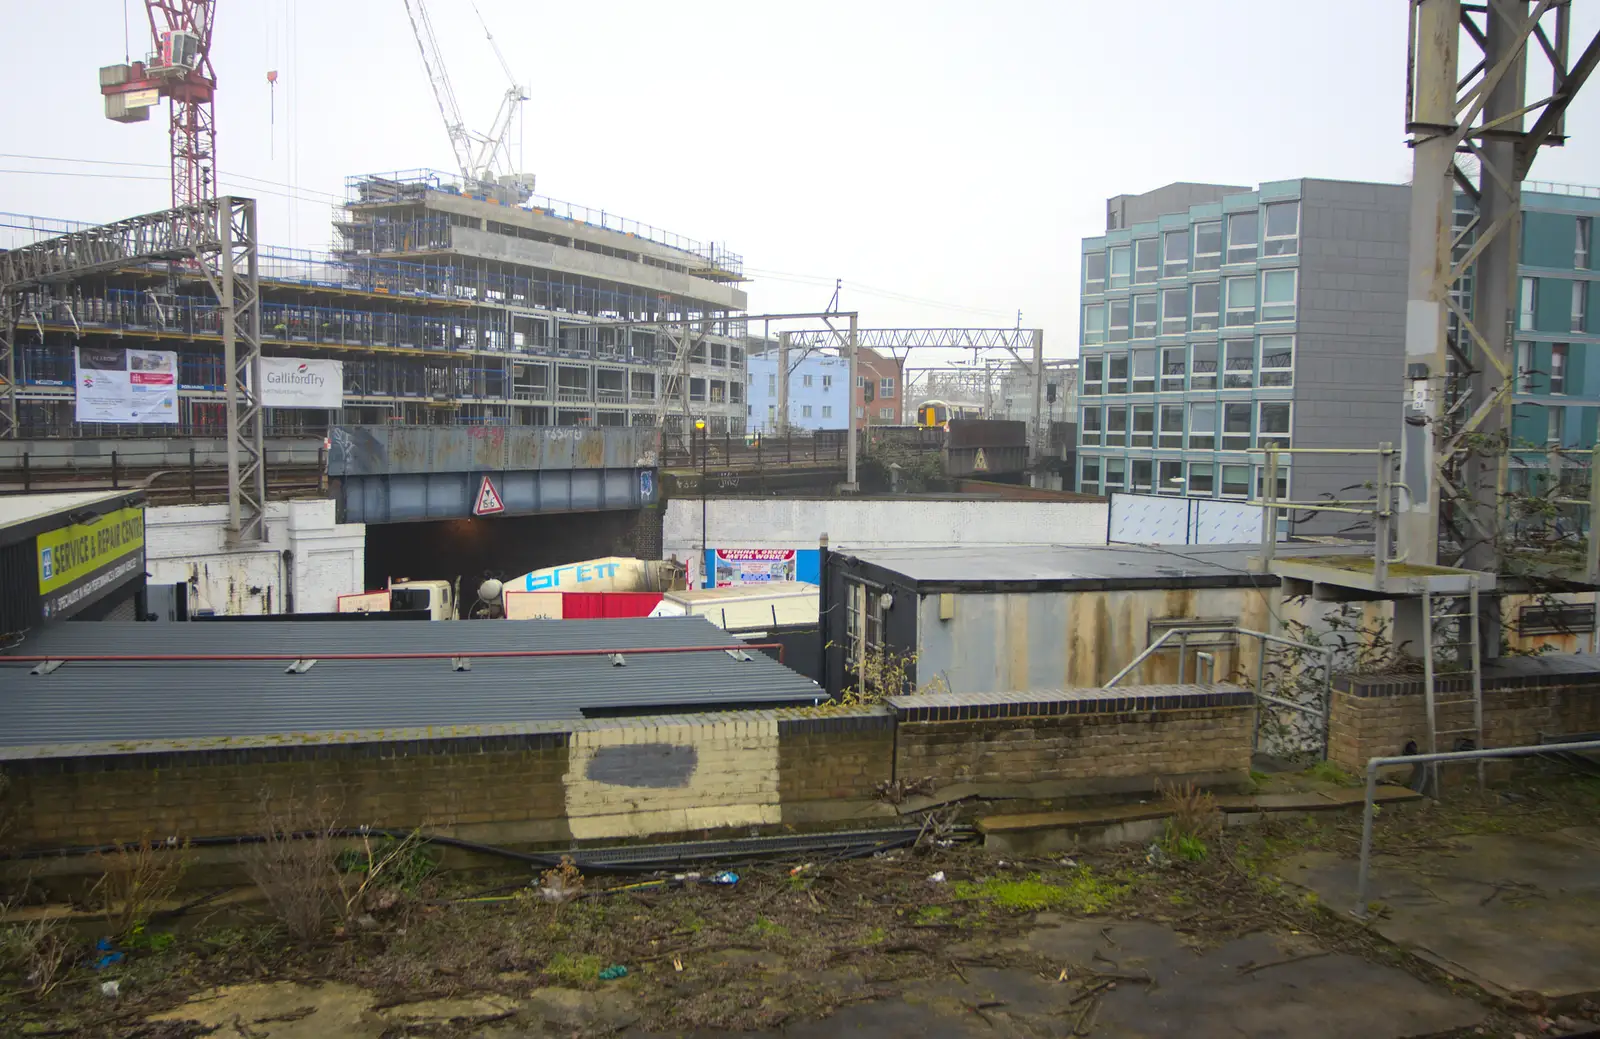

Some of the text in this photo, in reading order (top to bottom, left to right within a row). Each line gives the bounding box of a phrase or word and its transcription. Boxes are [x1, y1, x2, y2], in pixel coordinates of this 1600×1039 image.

[267, 372, 324, 387] GallifordTry
[54, 515, 143, 575] SERVICE & REPAIR CENTRE
